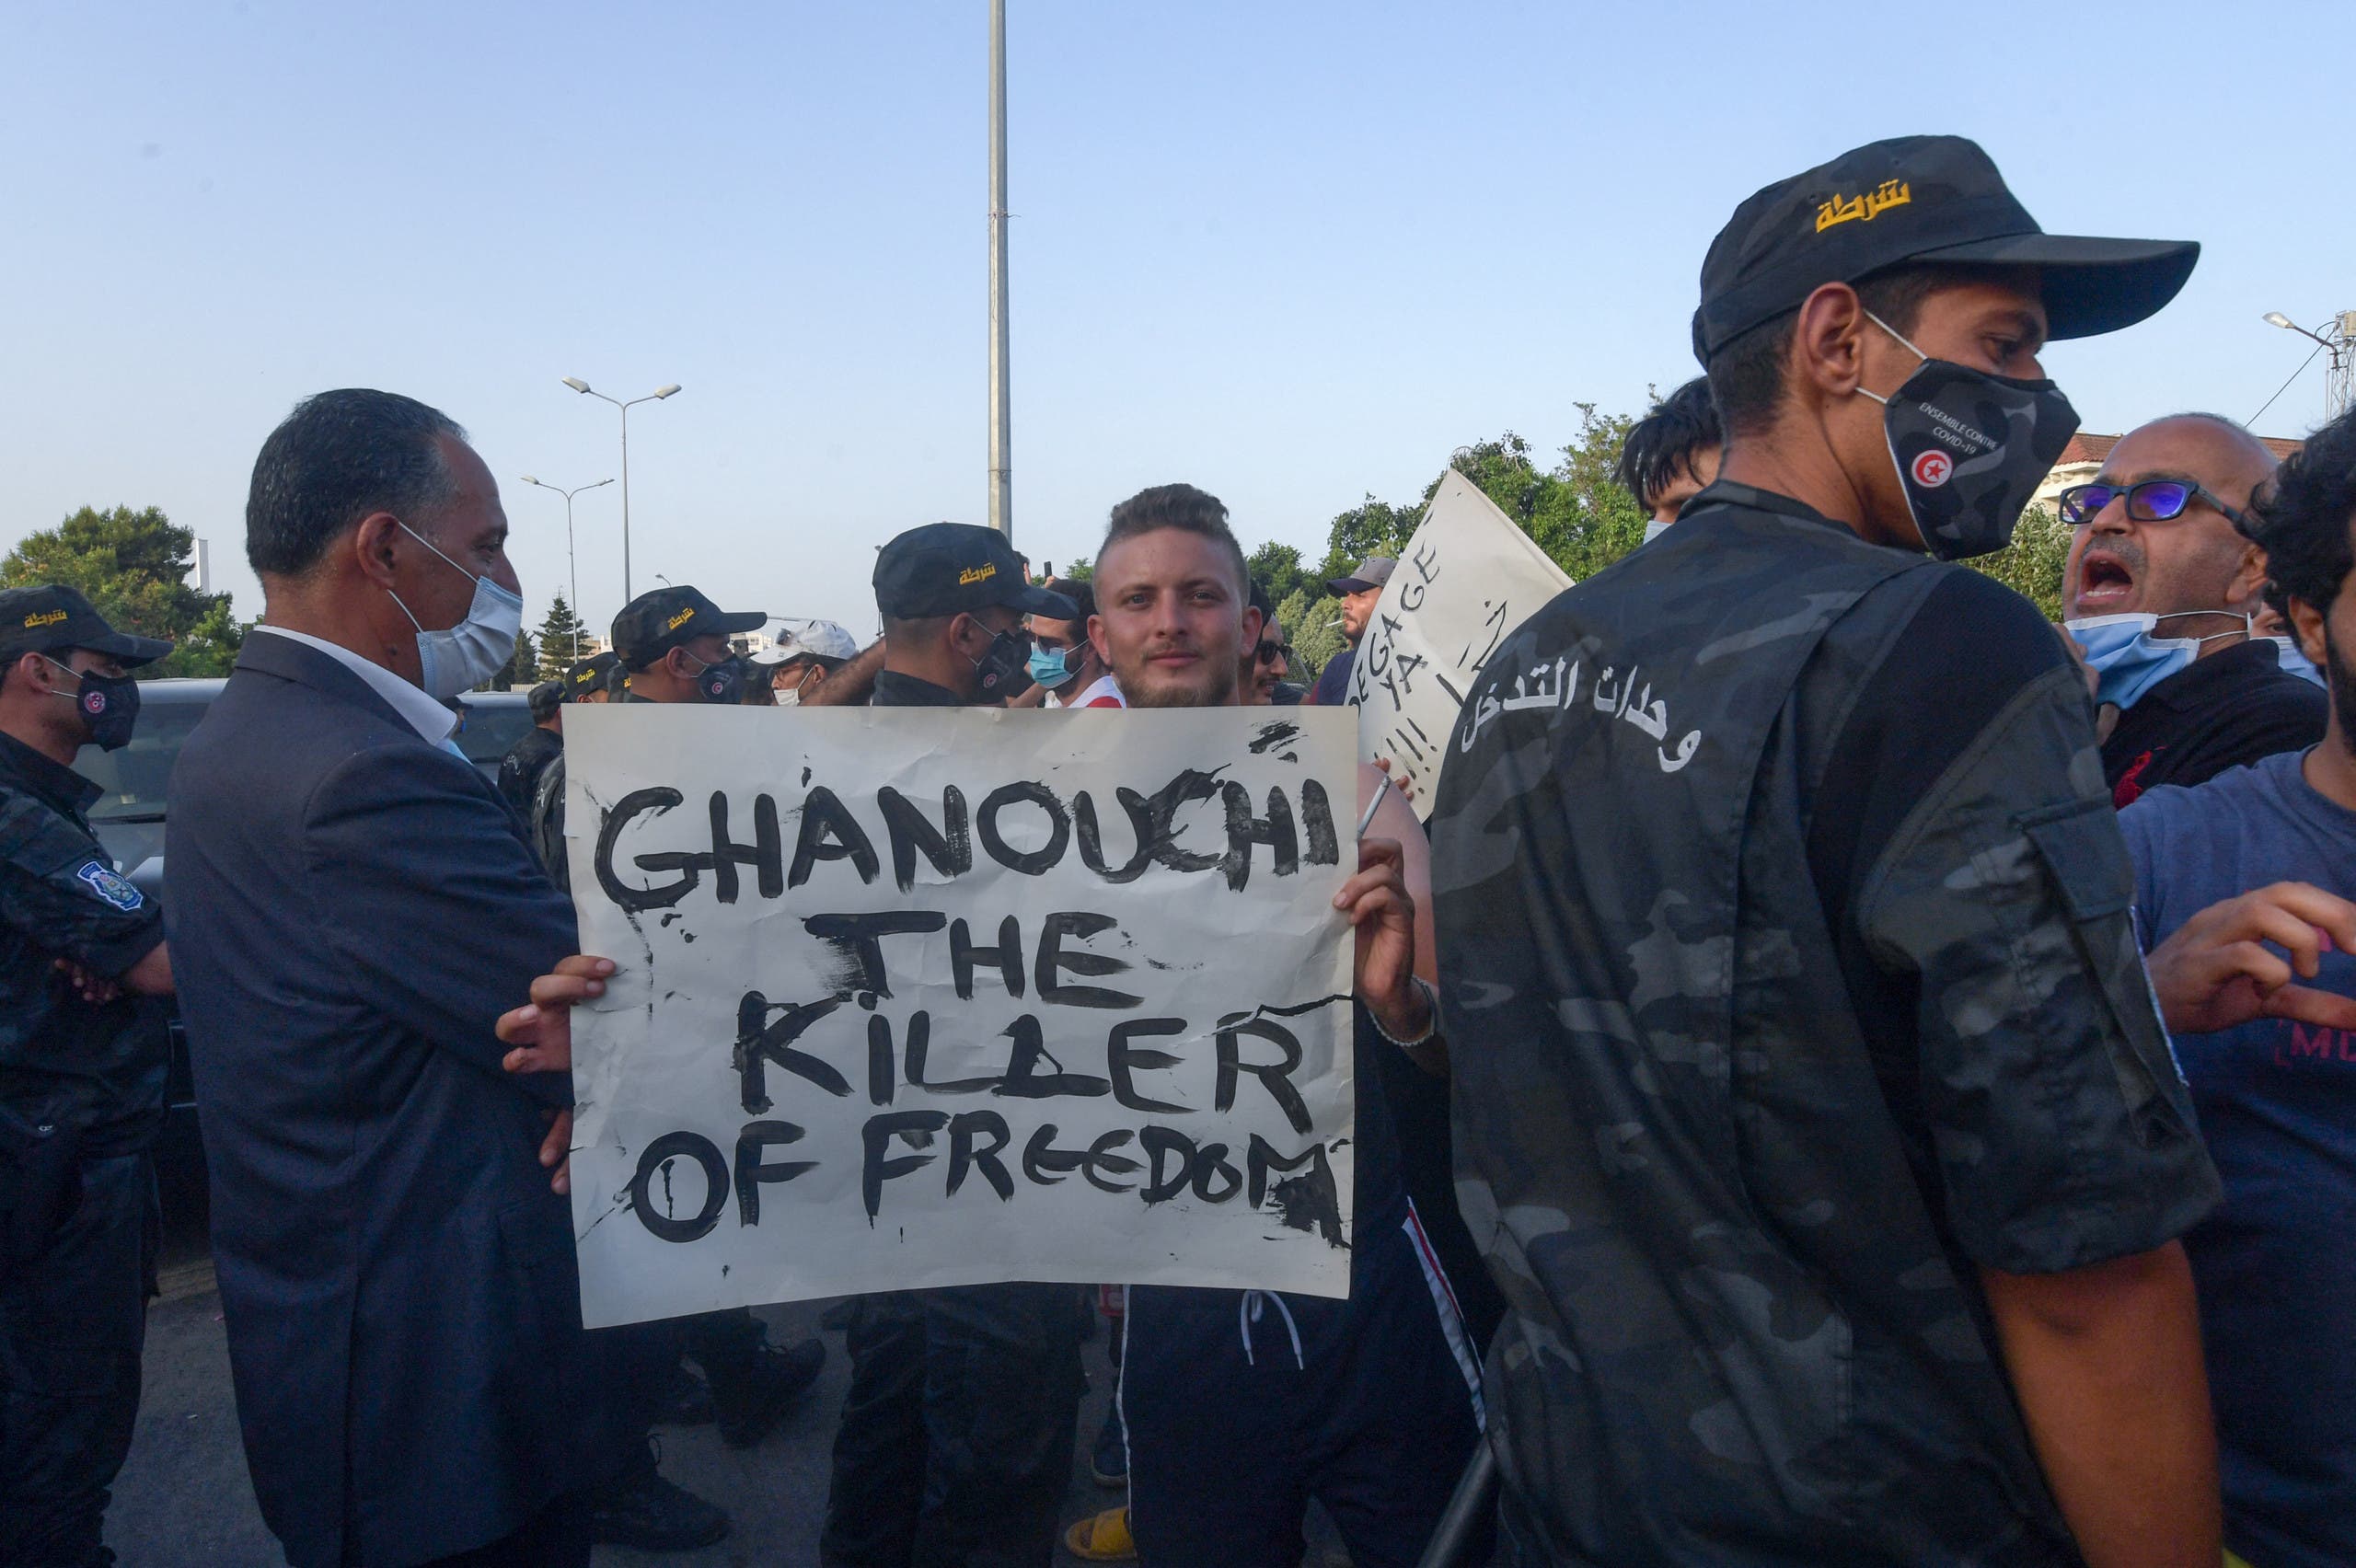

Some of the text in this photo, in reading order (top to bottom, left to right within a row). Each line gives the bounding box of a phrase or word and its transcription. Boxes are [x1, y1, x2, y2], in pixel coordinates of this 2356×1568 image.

[1816, 179, 1911, 234] شرطة
[1918, 402, 1998, 451] ENSEMBLE CONTRE
[959, 561, 997, 585] شرطة
[24, 608, 67, 628] شرطة
[668, 607, 696, 630] شرطة
[1461, 656, 1702, 773] وحدات التدخل
[594, 775, 1339, 912] GHANOUCHI
[803, 911, 1145, 1009] THE
[733, 991, 1314, 1135] KILLER
[631, 1110, 1351, 1249] OF FREEDOM
